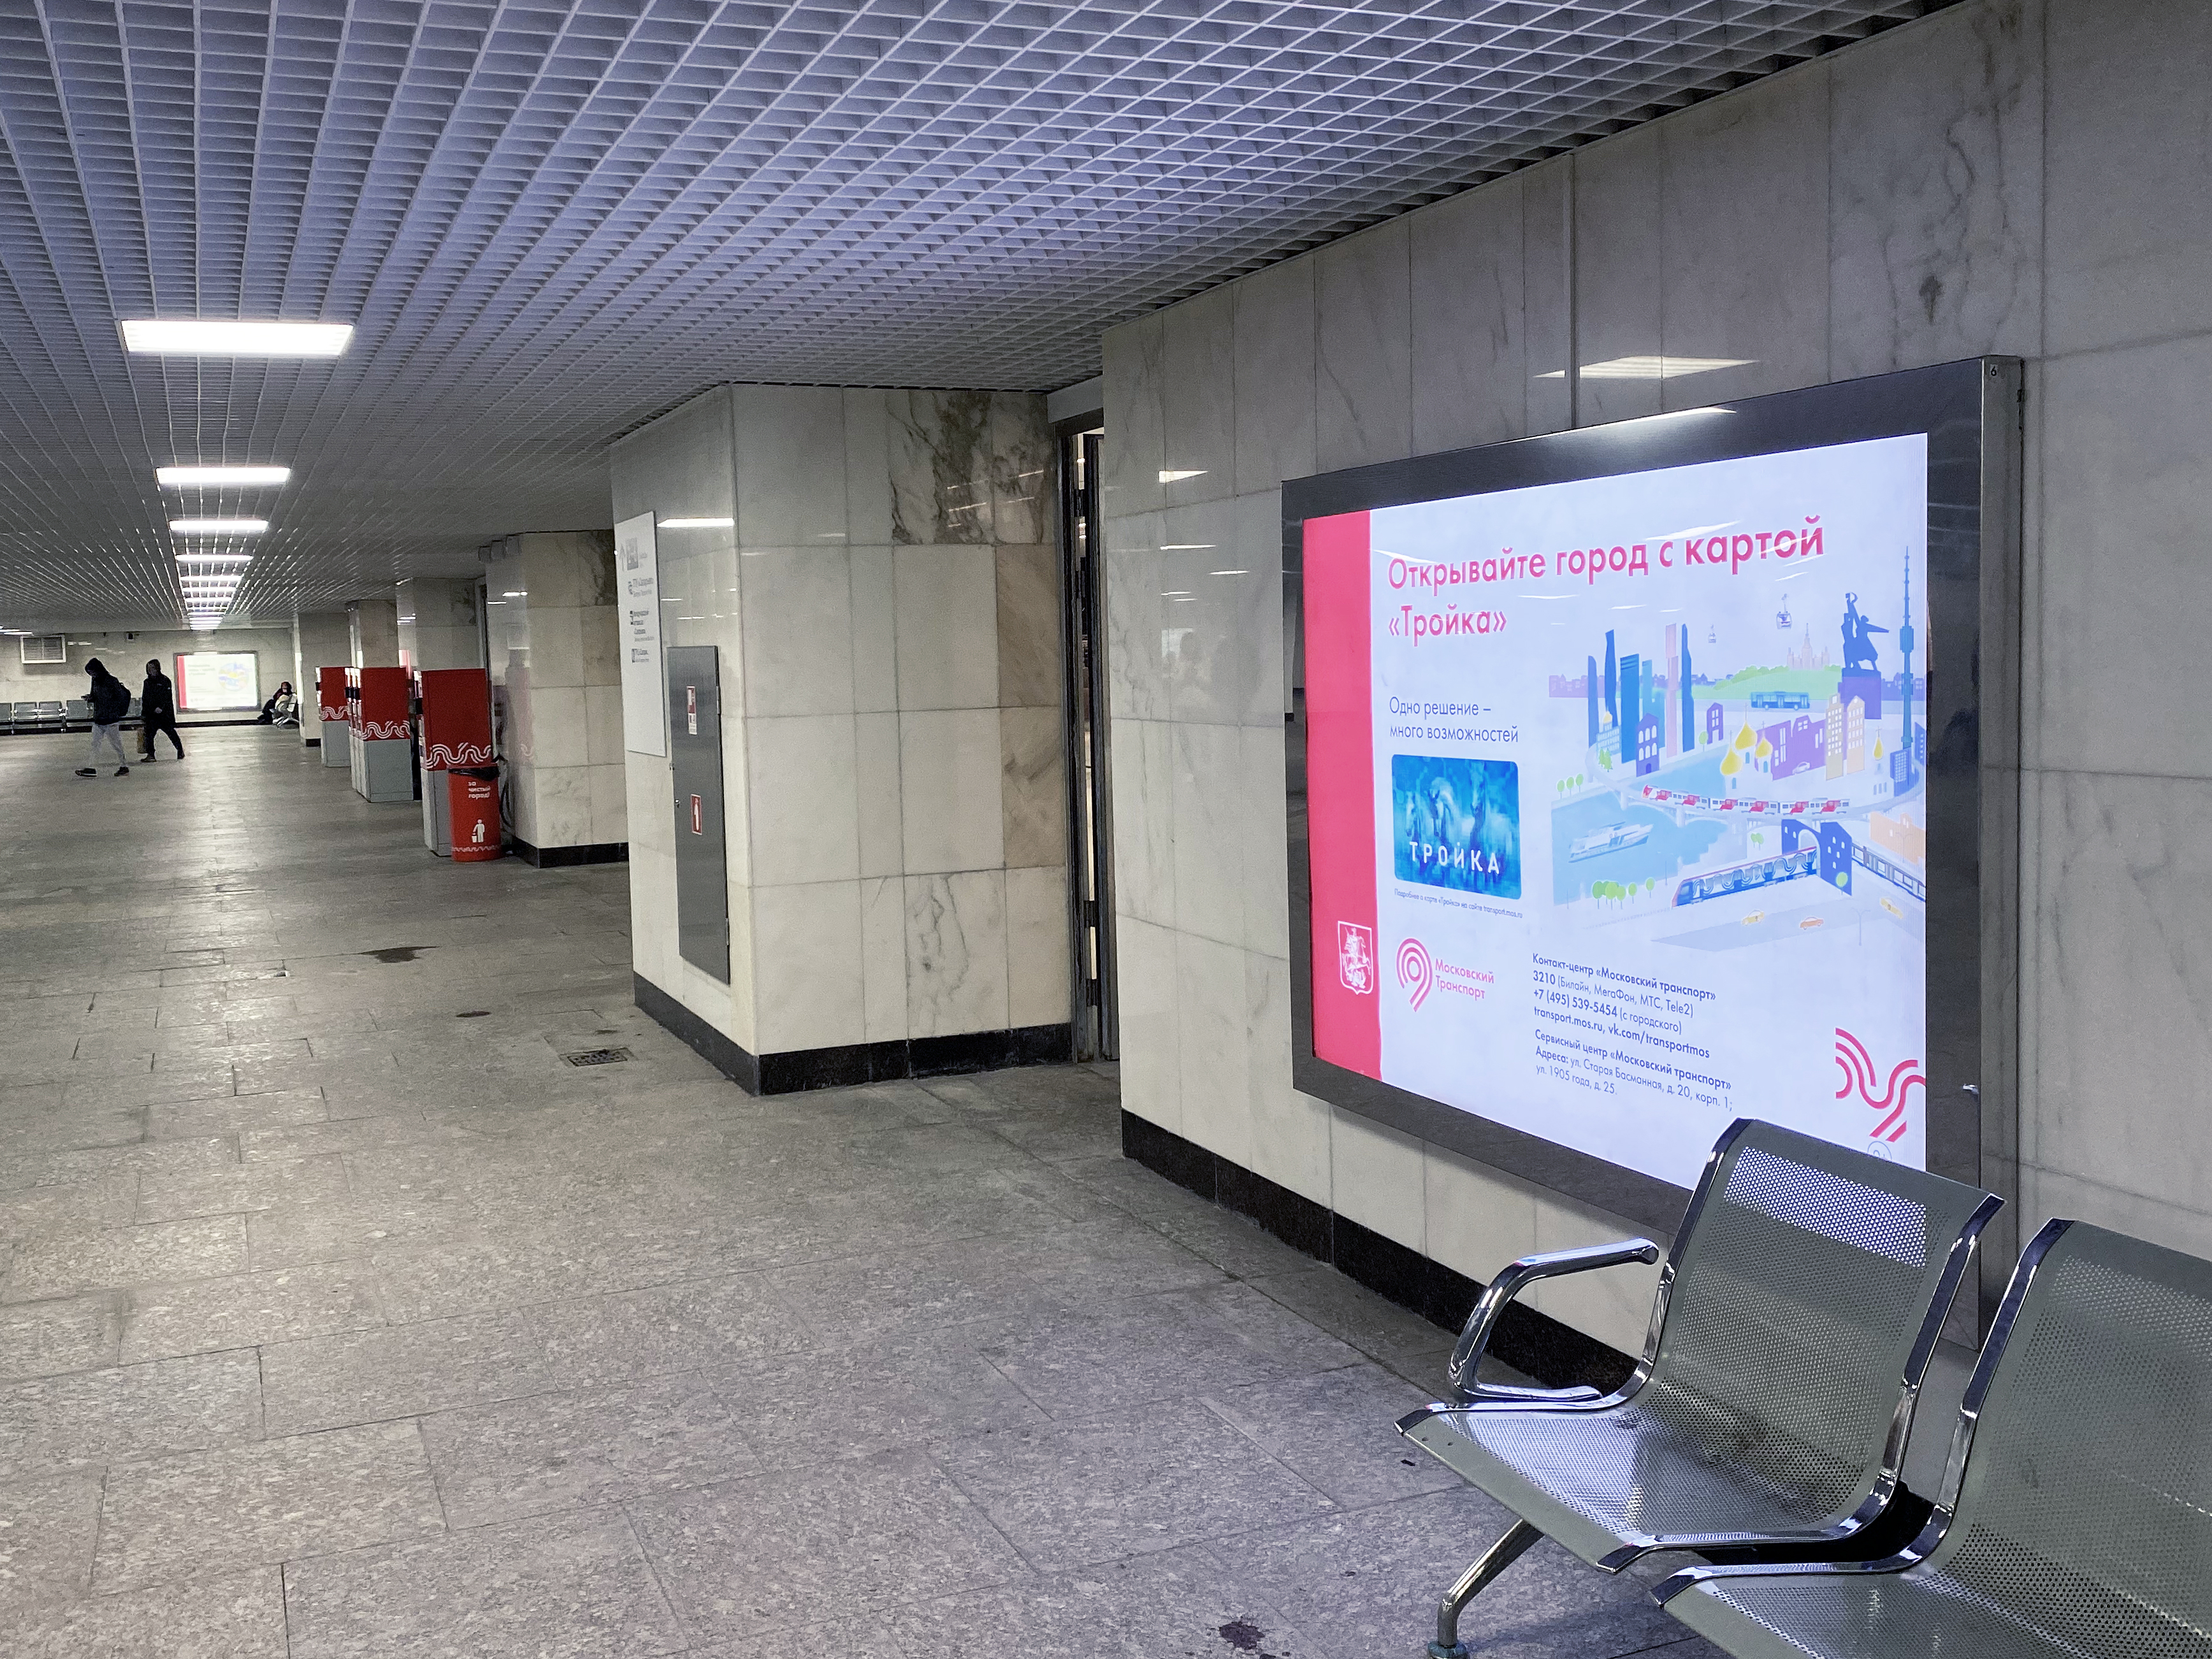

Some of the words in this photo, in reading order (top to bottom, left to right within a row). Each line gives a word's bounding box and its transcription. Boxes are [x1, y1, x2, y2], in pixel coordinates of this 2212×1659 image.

[1389, 547, 1547, 596] Открывайте
[1556, 542, 1647, 585] город
[1659, 540, 1673, 569] с
[1685, 515, 1825, 575] картой
[1389, 603, 1507, 646] «Тройка»
[1389, 697, 1420, 716] Одно
[1424, 701, 1478, 719] решение
[1390, 726, 1424, 739] много
[1428, 725, 1518, 743] возможностей
[1409, 841, 1500, 875] ТРОЙКА
[1484, 906, 1522, 918] transport.mos.ru
[1435, 959, 1494, 984] Московский
[1436, 977, 1486, 1000] Транспорт
[1533, 953, 1593, 978] Контакт-центр
[1596, 966, 1657, 989] «Московский
[1659, 981, 1716, 1001] транспорт»
[1533, 970, 1556, 986] 3210
[1558, 975, 1591, 996] (Билайн,
[1594, 984, 1637, 1005] МегаФон,
[1640, 995, 1663, 1010] МТС,
[1666, 1000, 1693, 1017] Tele2)
[1533, 988, 1543, 1001] +7
[1547, 990, 1570, 1009] (495)
[1573, 996, 1617, 1017] 539-5454
[1619, 1007, 1628, 1022] (с
[1630, 1012, 1682, 1035] городского)
[1534, 1007, 1606, 1035] transport.mos.ru,
[1608, 1023, 1709, 1059] vk.com/transportmos
[1535, 1030, 1580, 1051] Сервисный
[1582, 1042, 1608, 1058] центр
[1610, 1047, 1672, 1074] «Московский
[1674, 1068, 1731, 1090] транспорт»
[1536, 1045, 1569, 1065] Адреса:
[1571, 1056, 1582, 1070] ул.
[1584, 1058, 1614, 1077] Старая
[1616, 1066, 1664, 1091] Басманная,
[1667, 1081, 1675, 1095] д.
[1678, 1084, 1693, 1100] 20,
[1696, 1092, 1720, 1107] корп.
[1536, 1065, 1547, 1077] ул.
[1549, 1066, 1570, 1081] 1905
[1572, 1074, 1591, 1089] года,
[1594, 1079, 1601, 1093] д.
[1603, 1081, 1617, 1095] 25.
